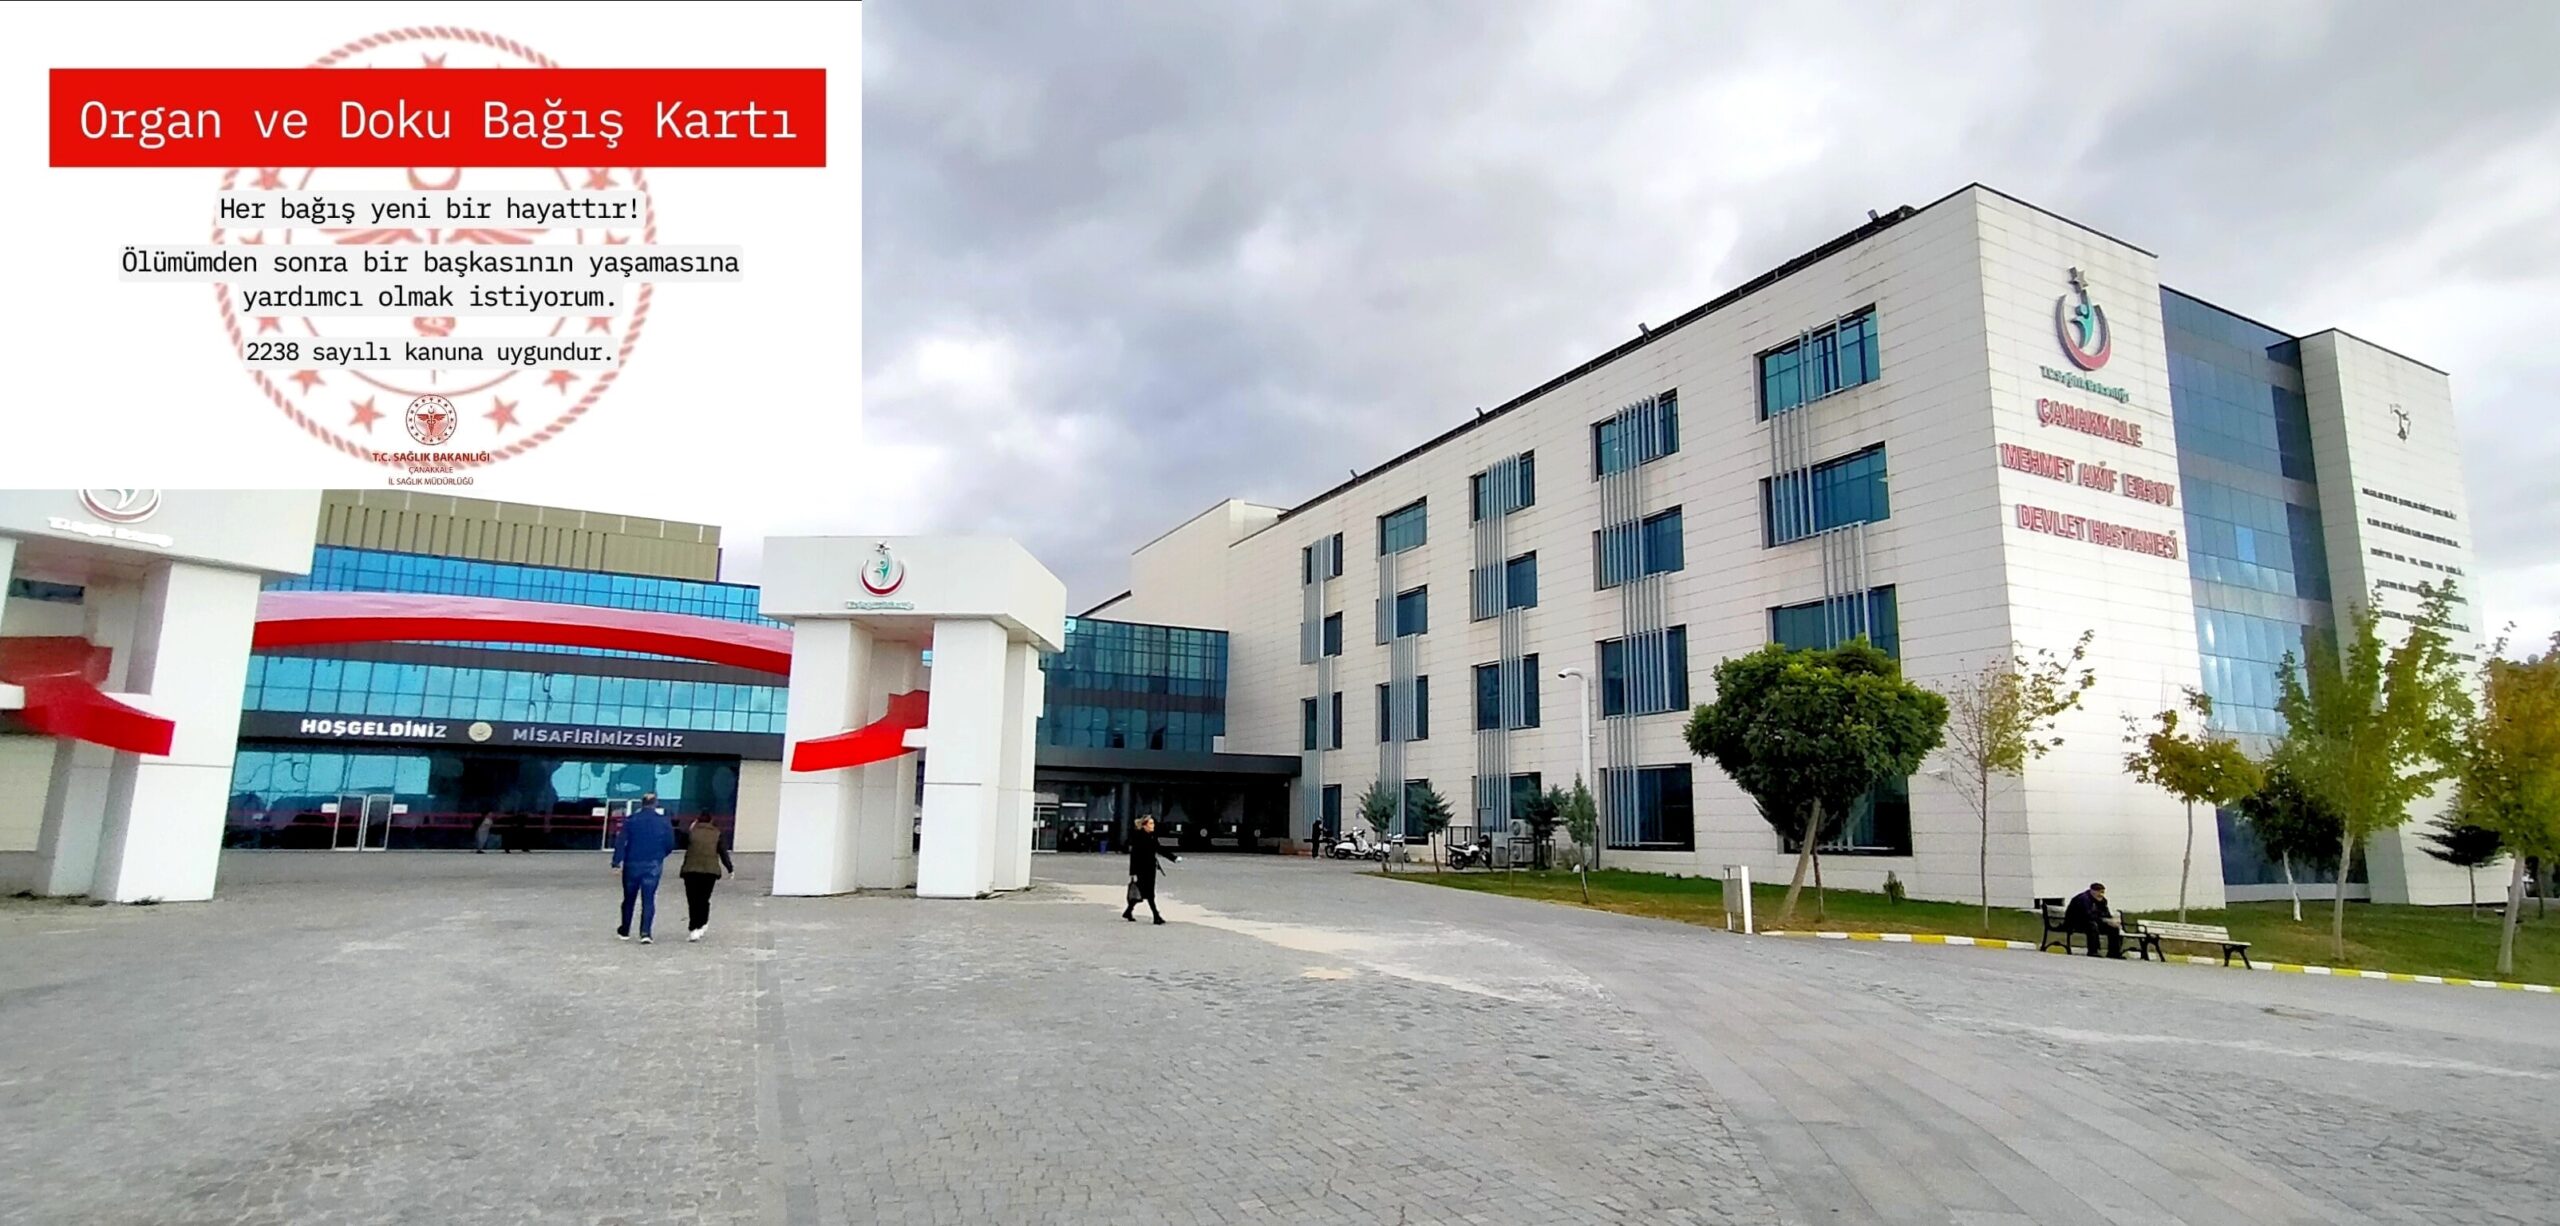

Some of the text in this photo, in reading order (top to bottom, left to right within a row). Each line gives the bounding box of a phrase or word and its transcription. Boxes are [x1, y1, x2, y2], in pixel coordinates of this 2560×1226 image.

[2036, 398, 2143, 447] ÇANAKKALE
[2000, 442, 2175, 507] MEHMET AKİF ERSOY
[2016, 503, 2179, 560] DEVLET HASTANESİ
[300, 717, 684, 749] HOŞGELDİNİZ MİSAFİRİMİZSİNİZ
